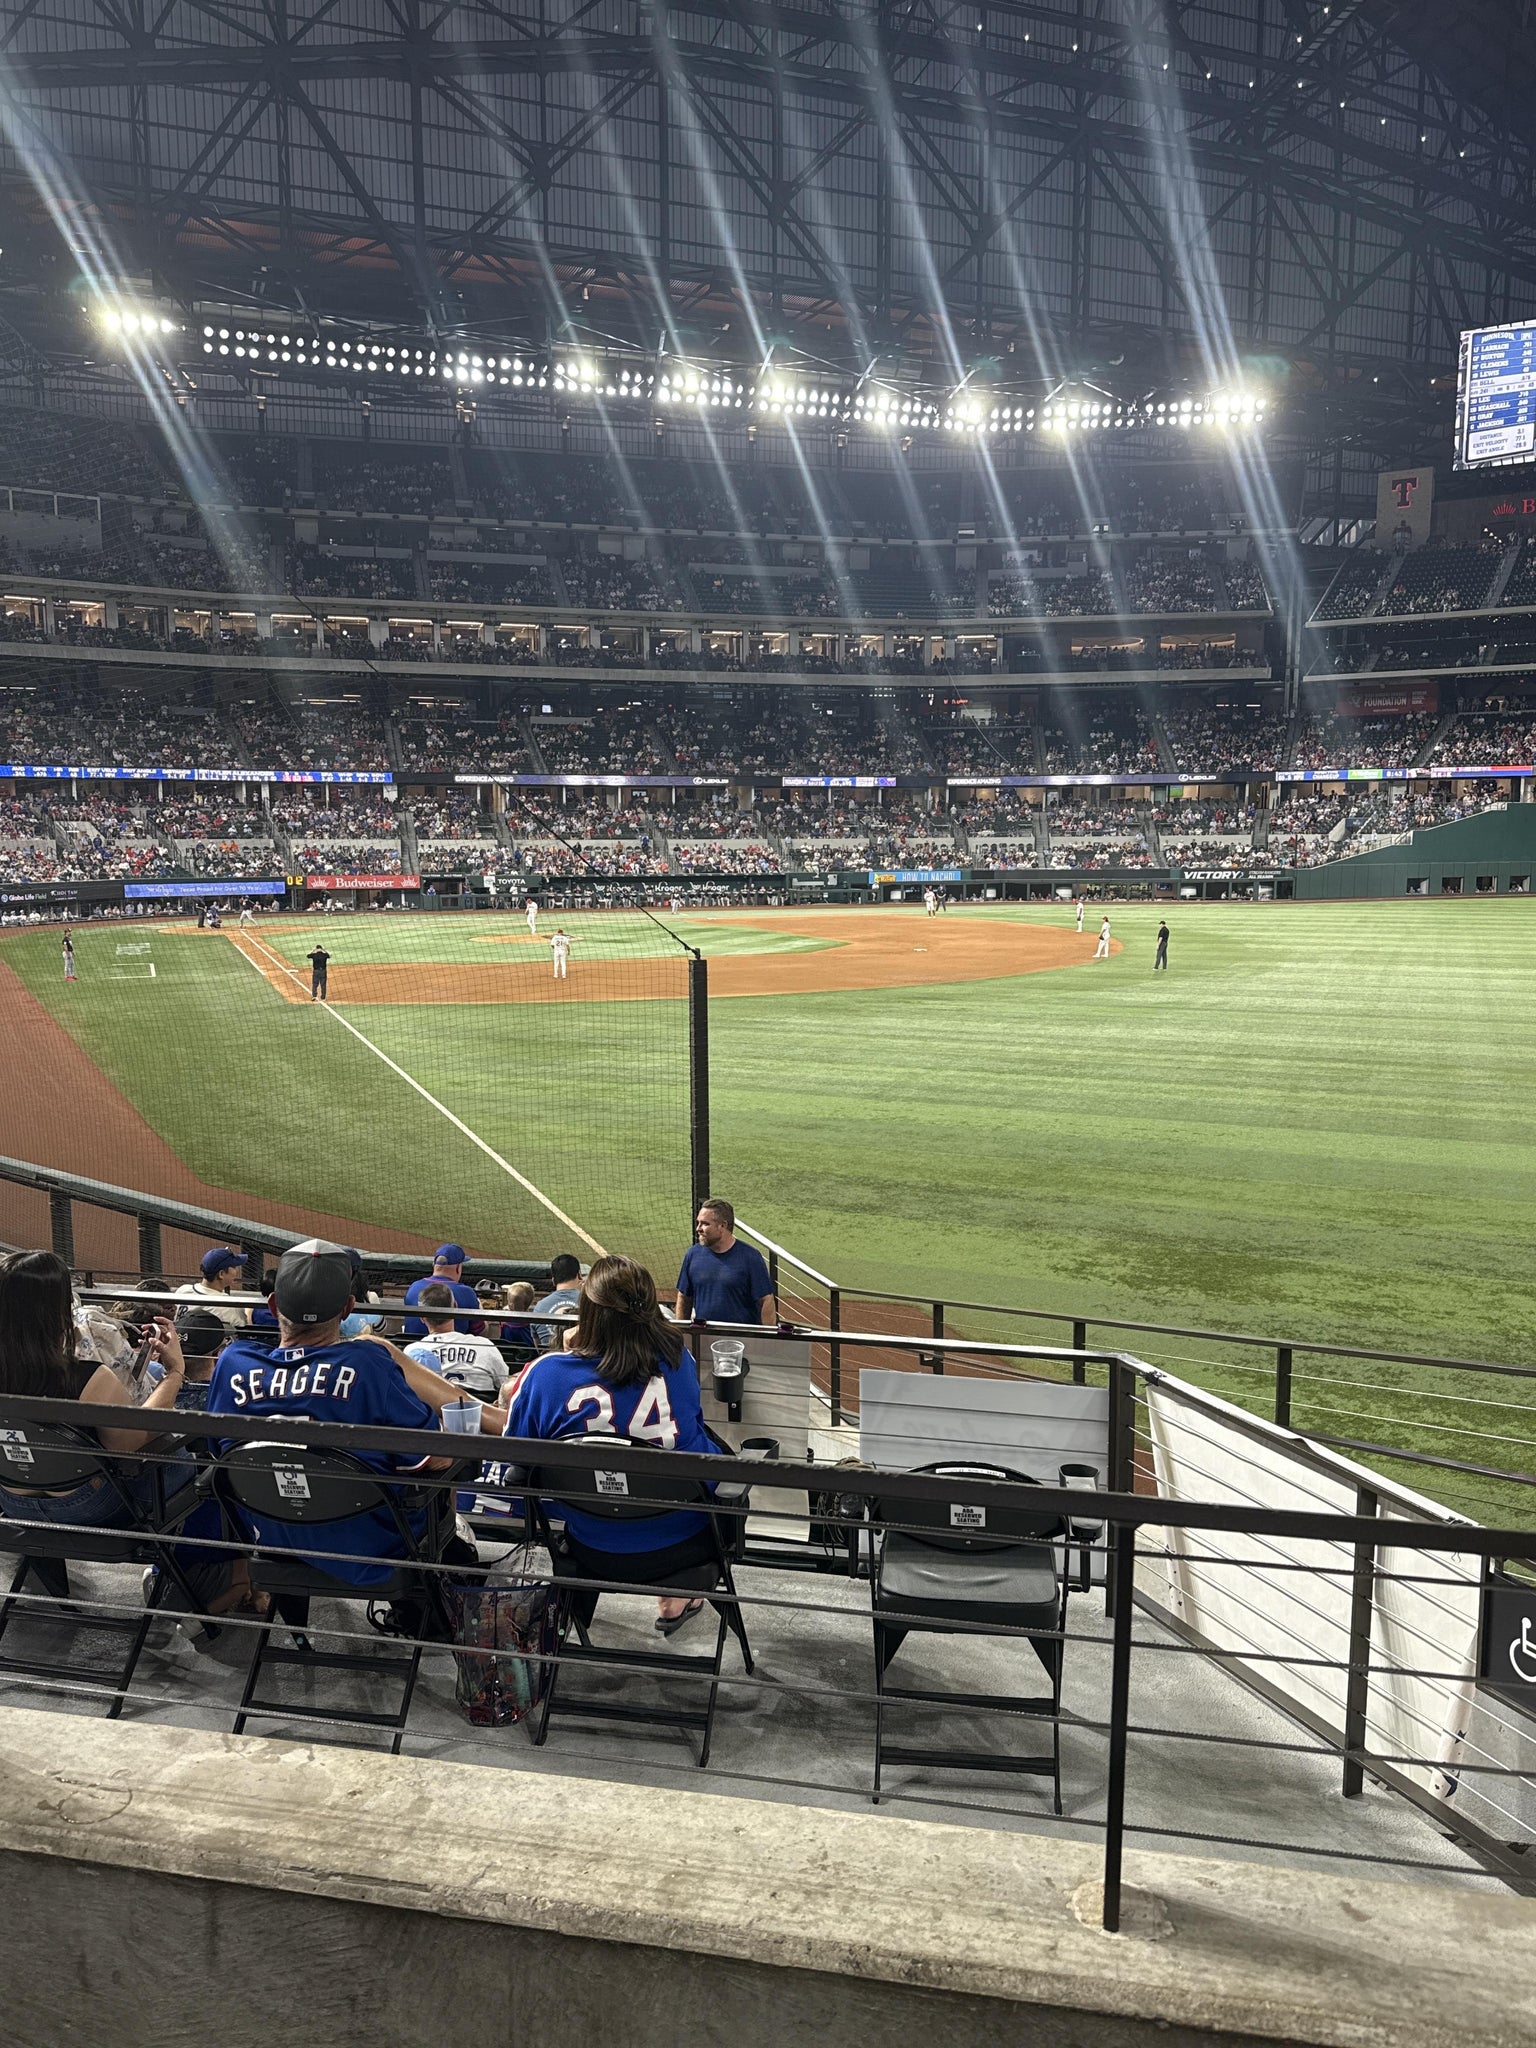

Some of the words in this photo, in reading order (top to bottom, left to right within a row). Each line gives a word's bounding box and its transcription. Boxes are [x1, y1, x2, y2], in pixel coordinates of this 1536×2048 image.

[1481, 332, 1515, 343] MINNESOTA
[1480, 370, 1500, 378] LEWIS
[1486, 438, 1508, 446] VELOCITY
[1392, 476, 1419, 510] T
[1364, 697, 1407, 706] FOUNDATION
[902, 872, 918, 882] HOW
[920, 872, 928, 881] TO
[931, 872, 956, 881] NACHO!
[336, 878, 394, 888] Budweiser
[432, 1347, 476, 1364] FORD
[230, 1364, 356, 1406] SEAGER
[566, 1374, 680, 1450] 34
